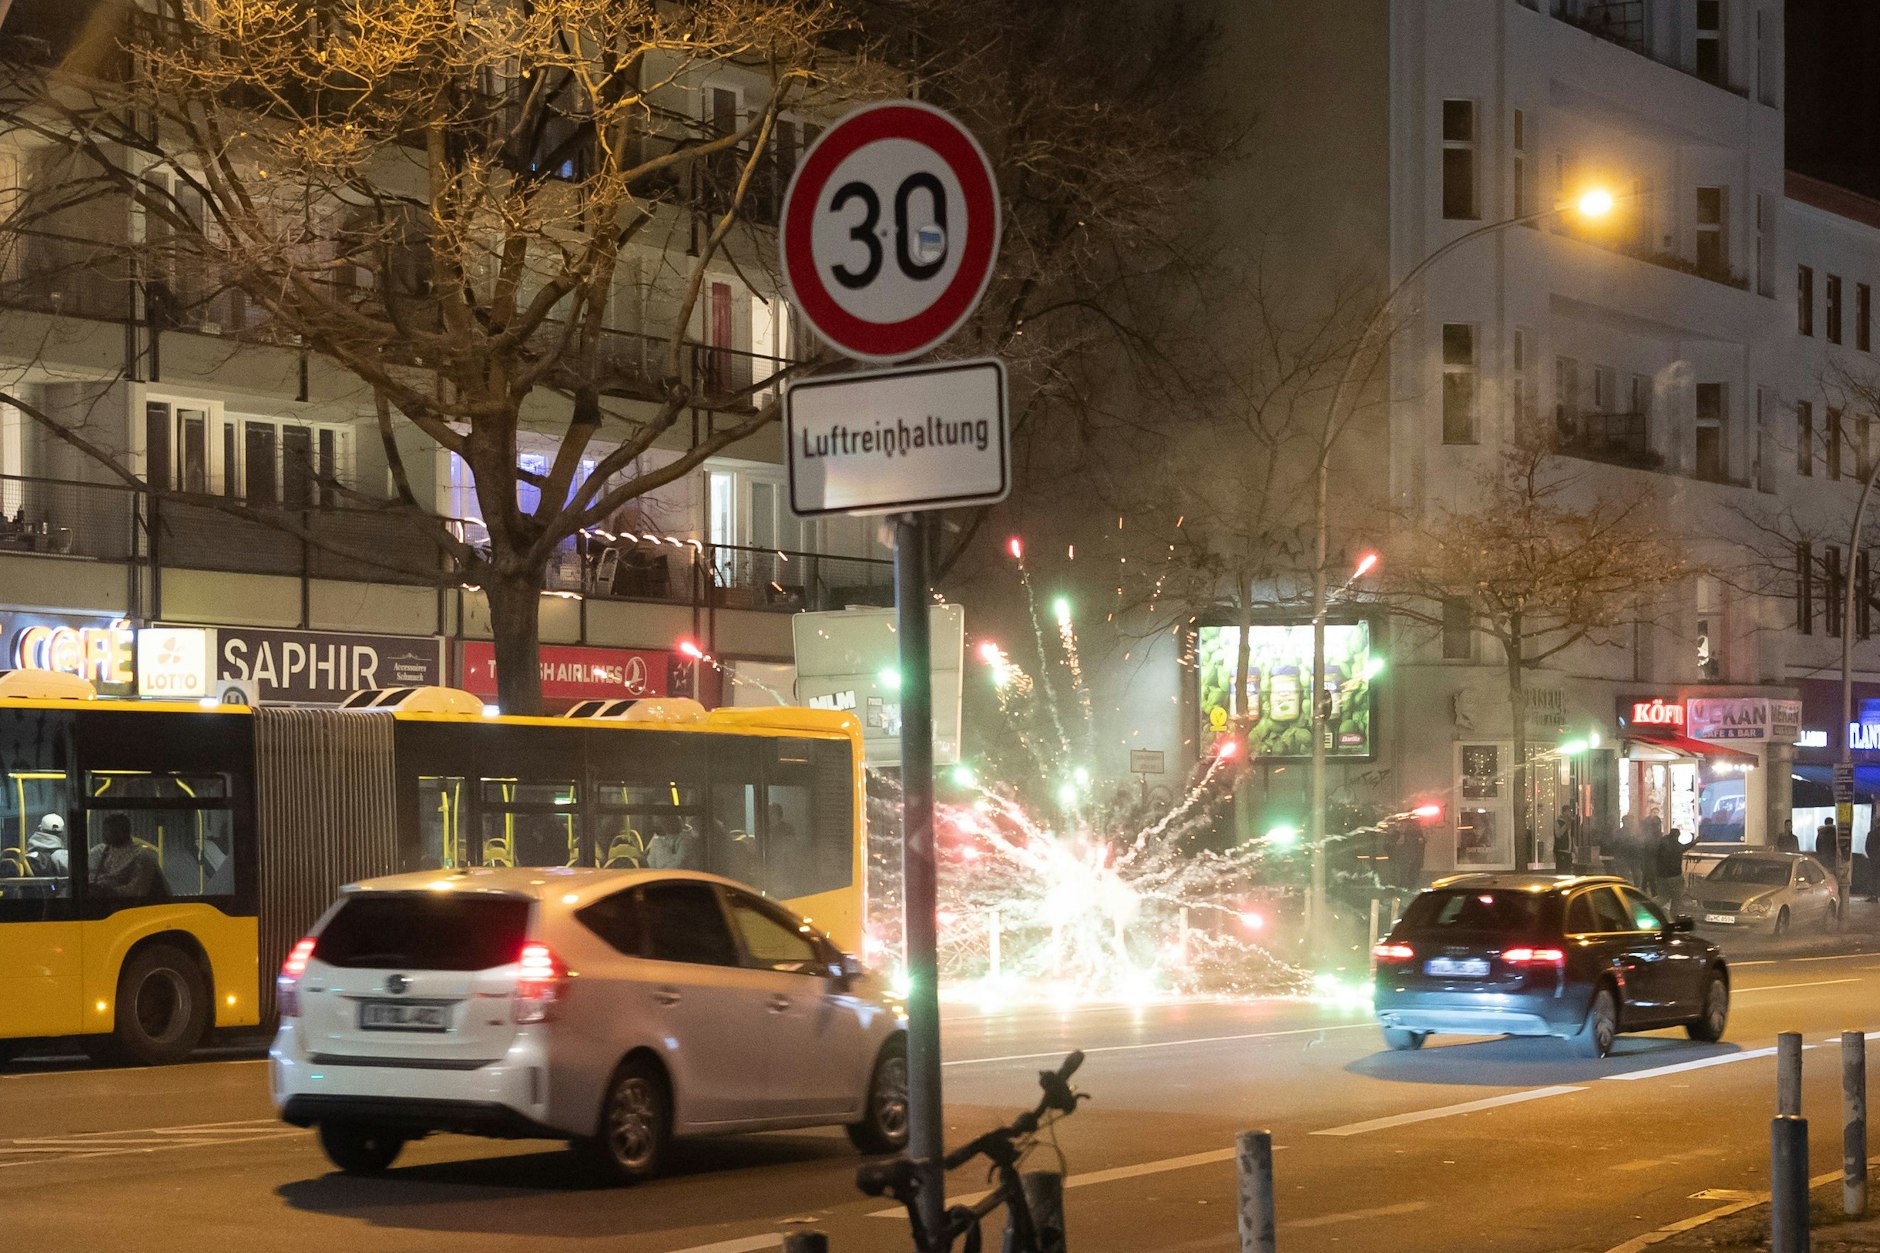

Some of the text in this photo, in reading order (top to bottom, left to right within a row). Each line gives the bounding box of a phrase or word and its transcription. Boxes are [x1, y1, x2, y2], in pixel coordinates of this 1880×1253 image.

[829, 171, 948, 290] 30
[802, 416, 989, 458] Luftreinhaltung
[147, 674, 197, 689] LOTTO
[223, 637, 379, 692] SAPHIR
[1737, 729, 1757, 738] BAR
